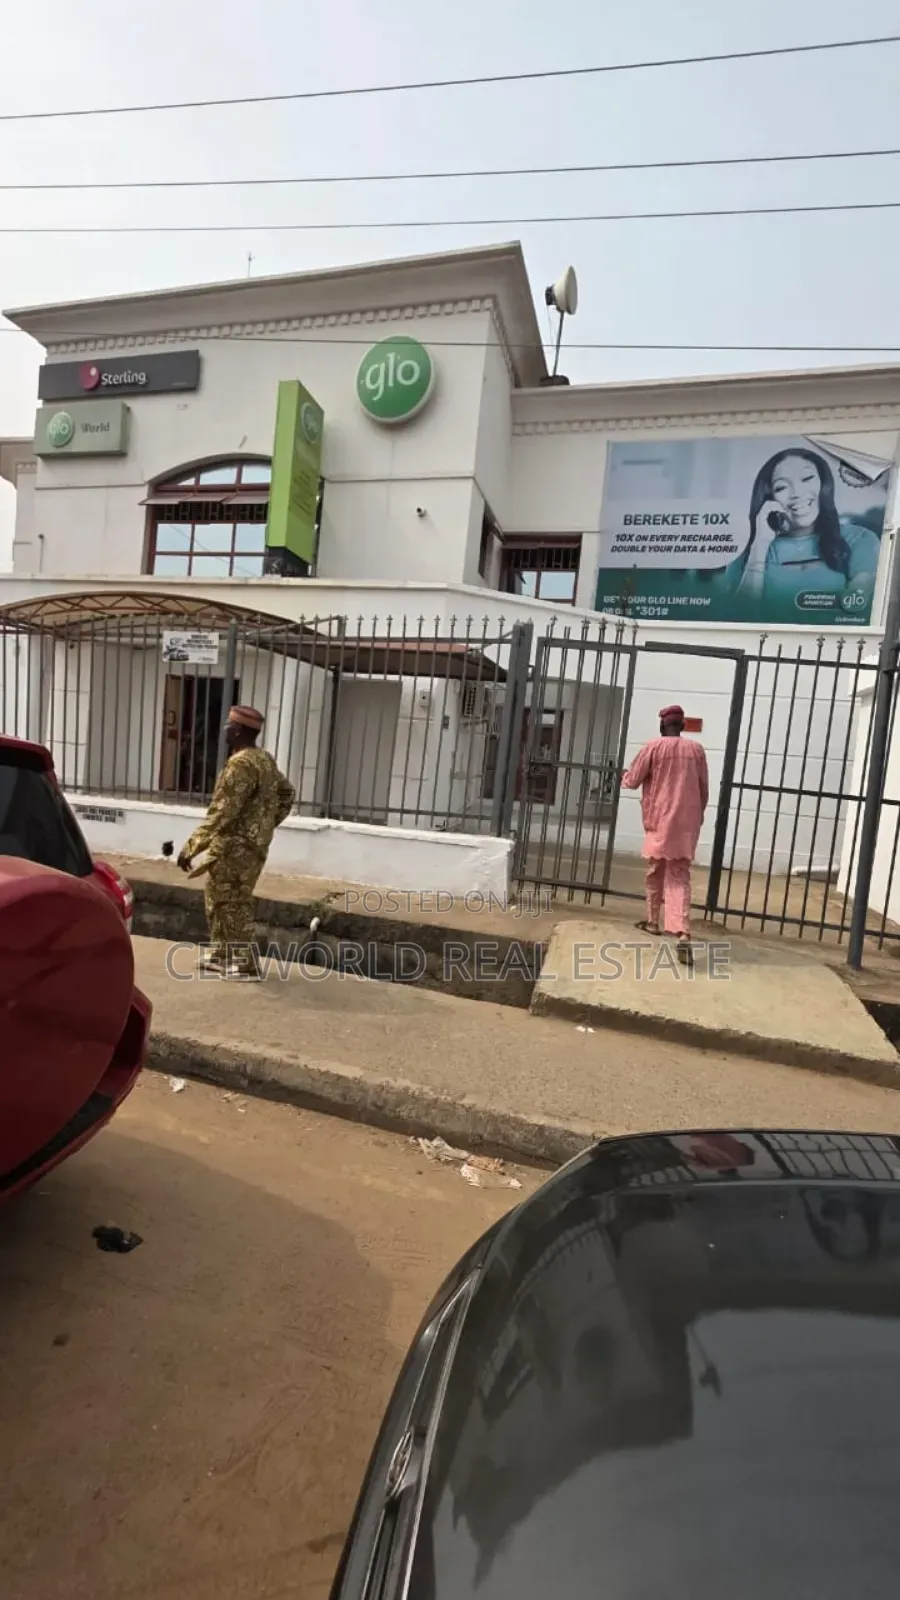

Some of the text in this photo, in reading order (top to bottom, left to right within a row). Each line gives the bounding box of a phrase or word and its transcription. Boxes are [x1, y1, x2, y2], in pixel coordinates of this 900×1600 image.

[101, 370, 146, 385] Sterling
[365, 352, 421, 401] glo
[50, 420, 69, 441] glo
[81, 422, 110, 432] World
[623, 513, 730, 526] BEREKETE 10X
[615, 533, 635, 542] 10X
[635, 534, 649, 542] ON
[649, 534, 680, 542] EVERY
[611, 545, 739, 553] DOUBLE YOUR DATA & MORE!
[603, 595, 711, 606] GE OUR GLO LINE NOW
[843, 593, 865, 609] glo
